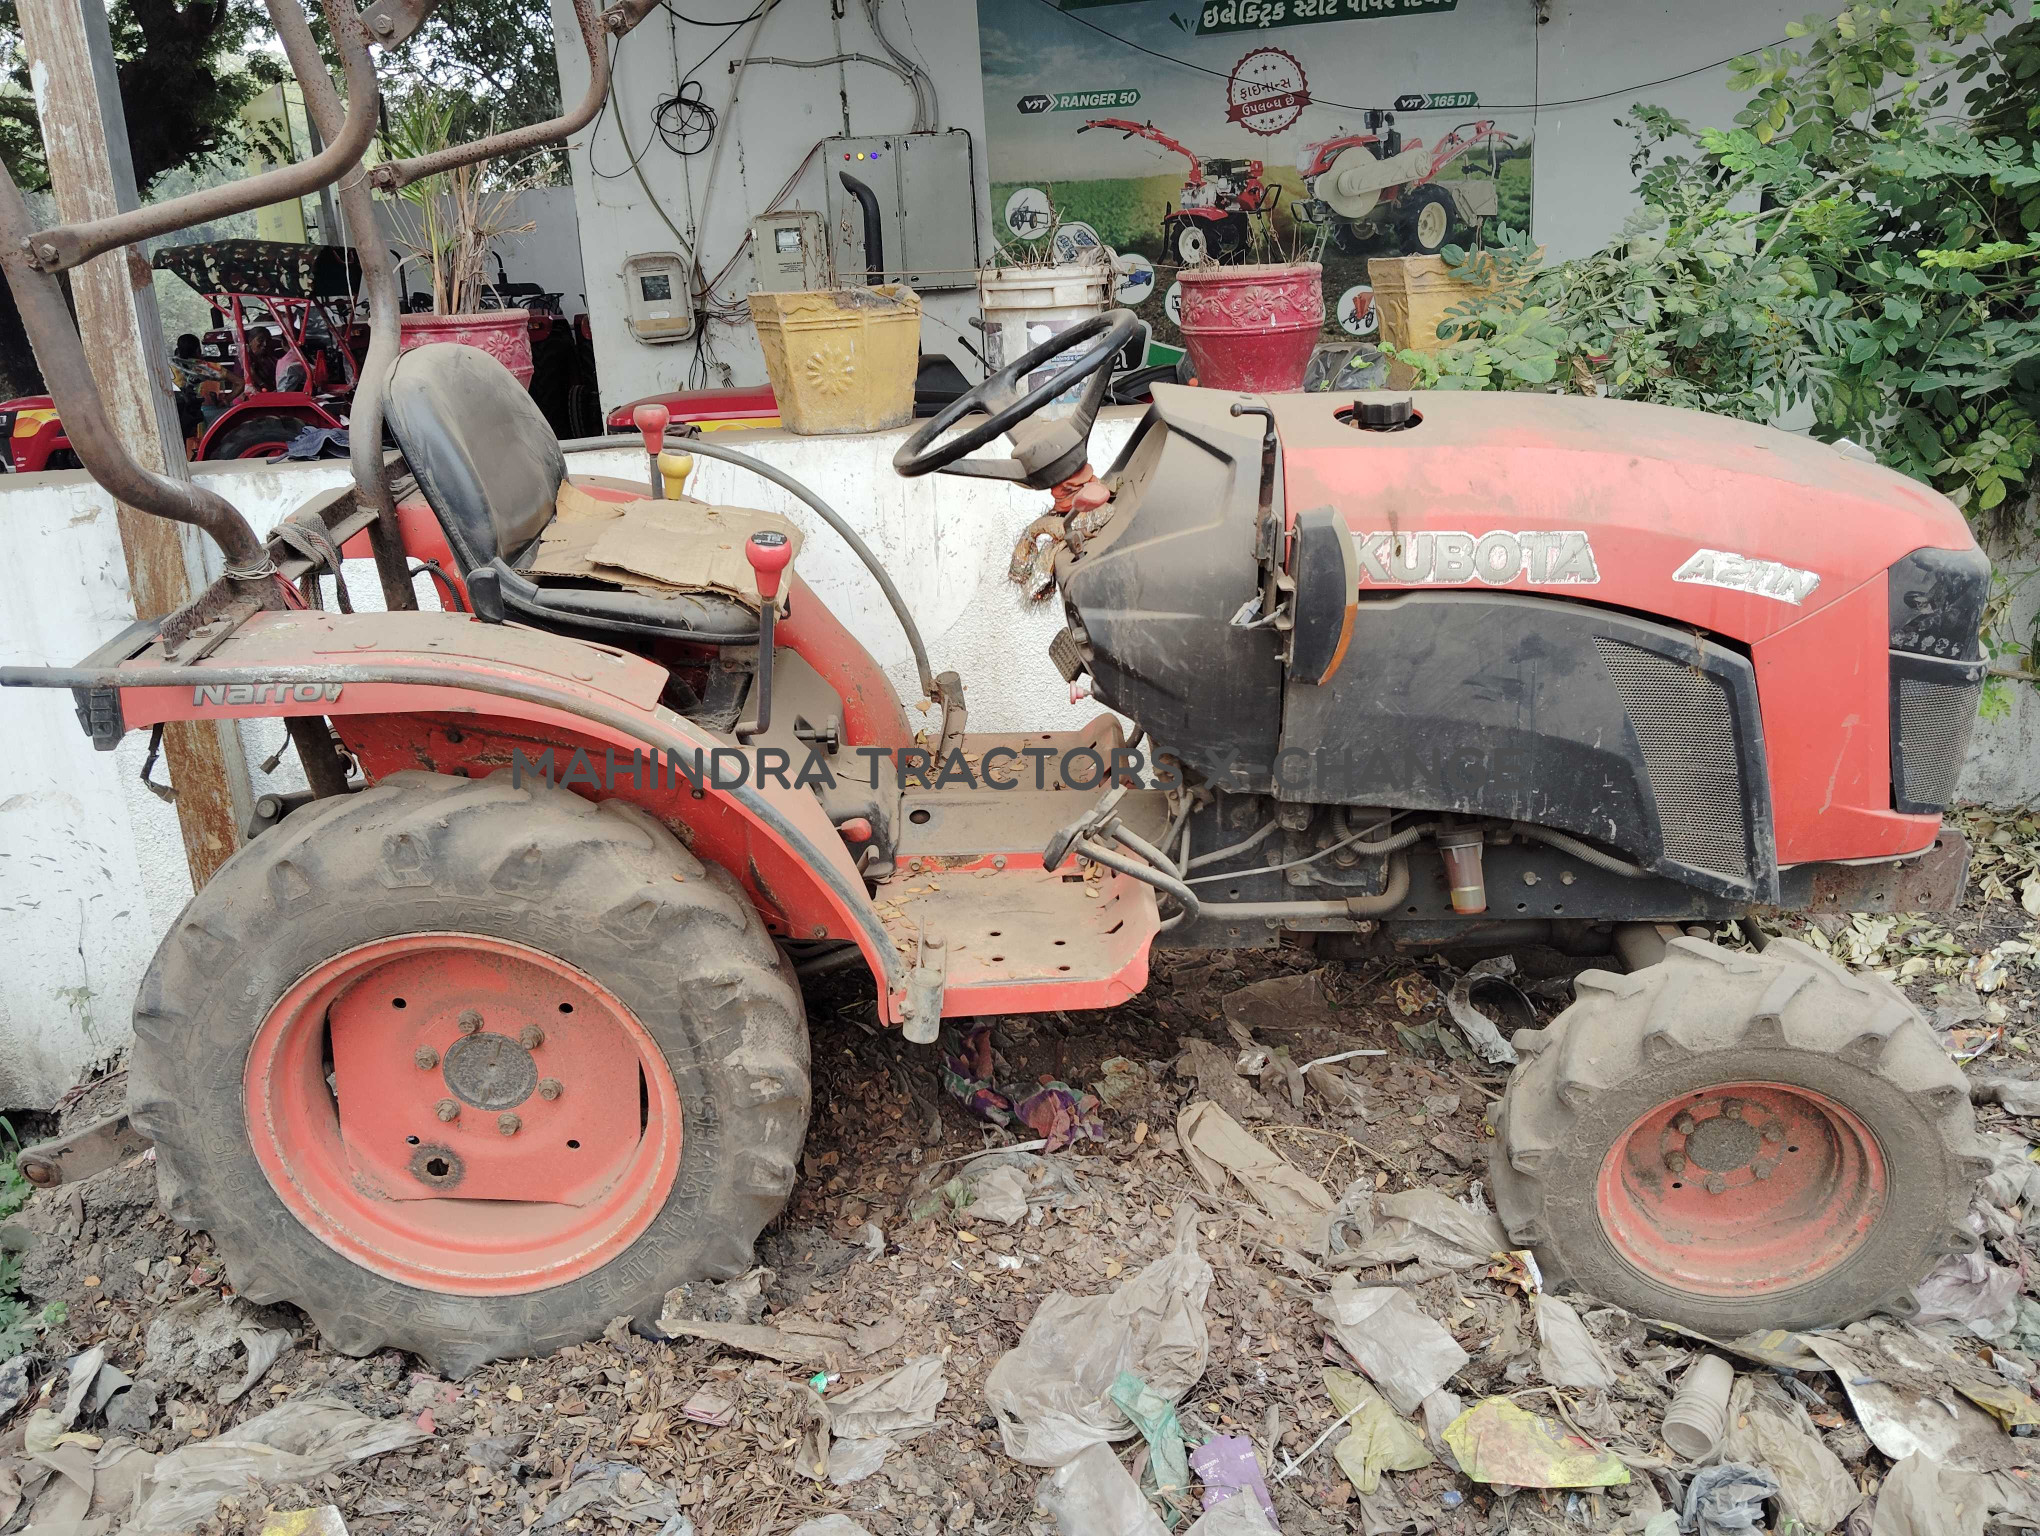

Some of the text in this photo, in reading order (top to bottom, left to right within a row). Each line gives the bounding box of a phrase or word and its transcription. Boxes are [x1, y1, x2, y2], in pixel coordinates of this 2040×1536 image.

[1060, 93, 1117, 108] RANGER
[1119, 91, 1137, 104] 50
[1434, 95, 1455, 107] 165
[1457, 94, 1472, 106] DI
[1352, 532, 1599, 584] KUBOTA
